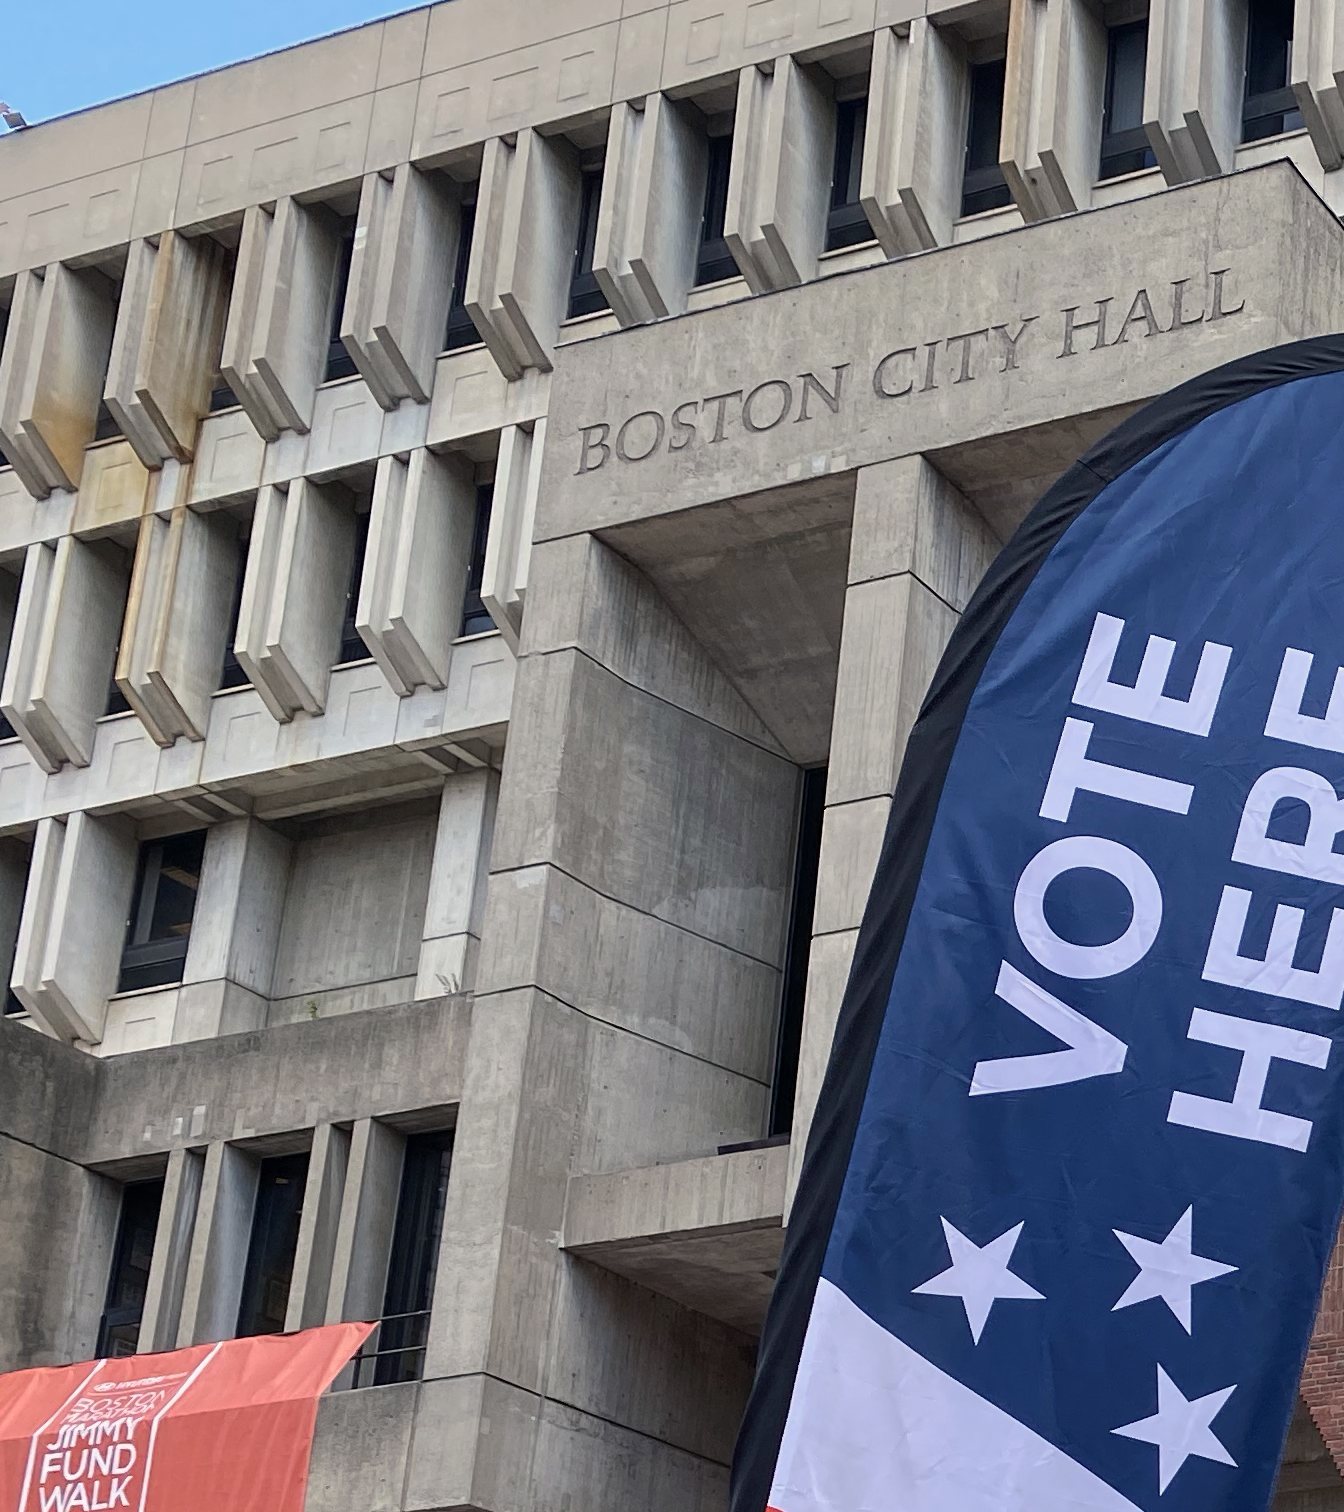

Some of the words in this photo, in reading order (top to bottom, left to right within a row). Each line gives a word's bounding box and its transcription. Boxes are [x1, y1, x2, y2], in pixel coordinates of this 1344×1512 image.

[574, 364, 849, 476] BOSTON
[872, 315, 1039, 400] CITY
[1056, 267, 1247, 360] HALL
[968, 611, 1233, 1097] VOTE
[71, 1390, 165, 1413] BOSTON
[46, 1416, 145, 1450] JIMMY
[39, 1443, 137, 1484] FUND
